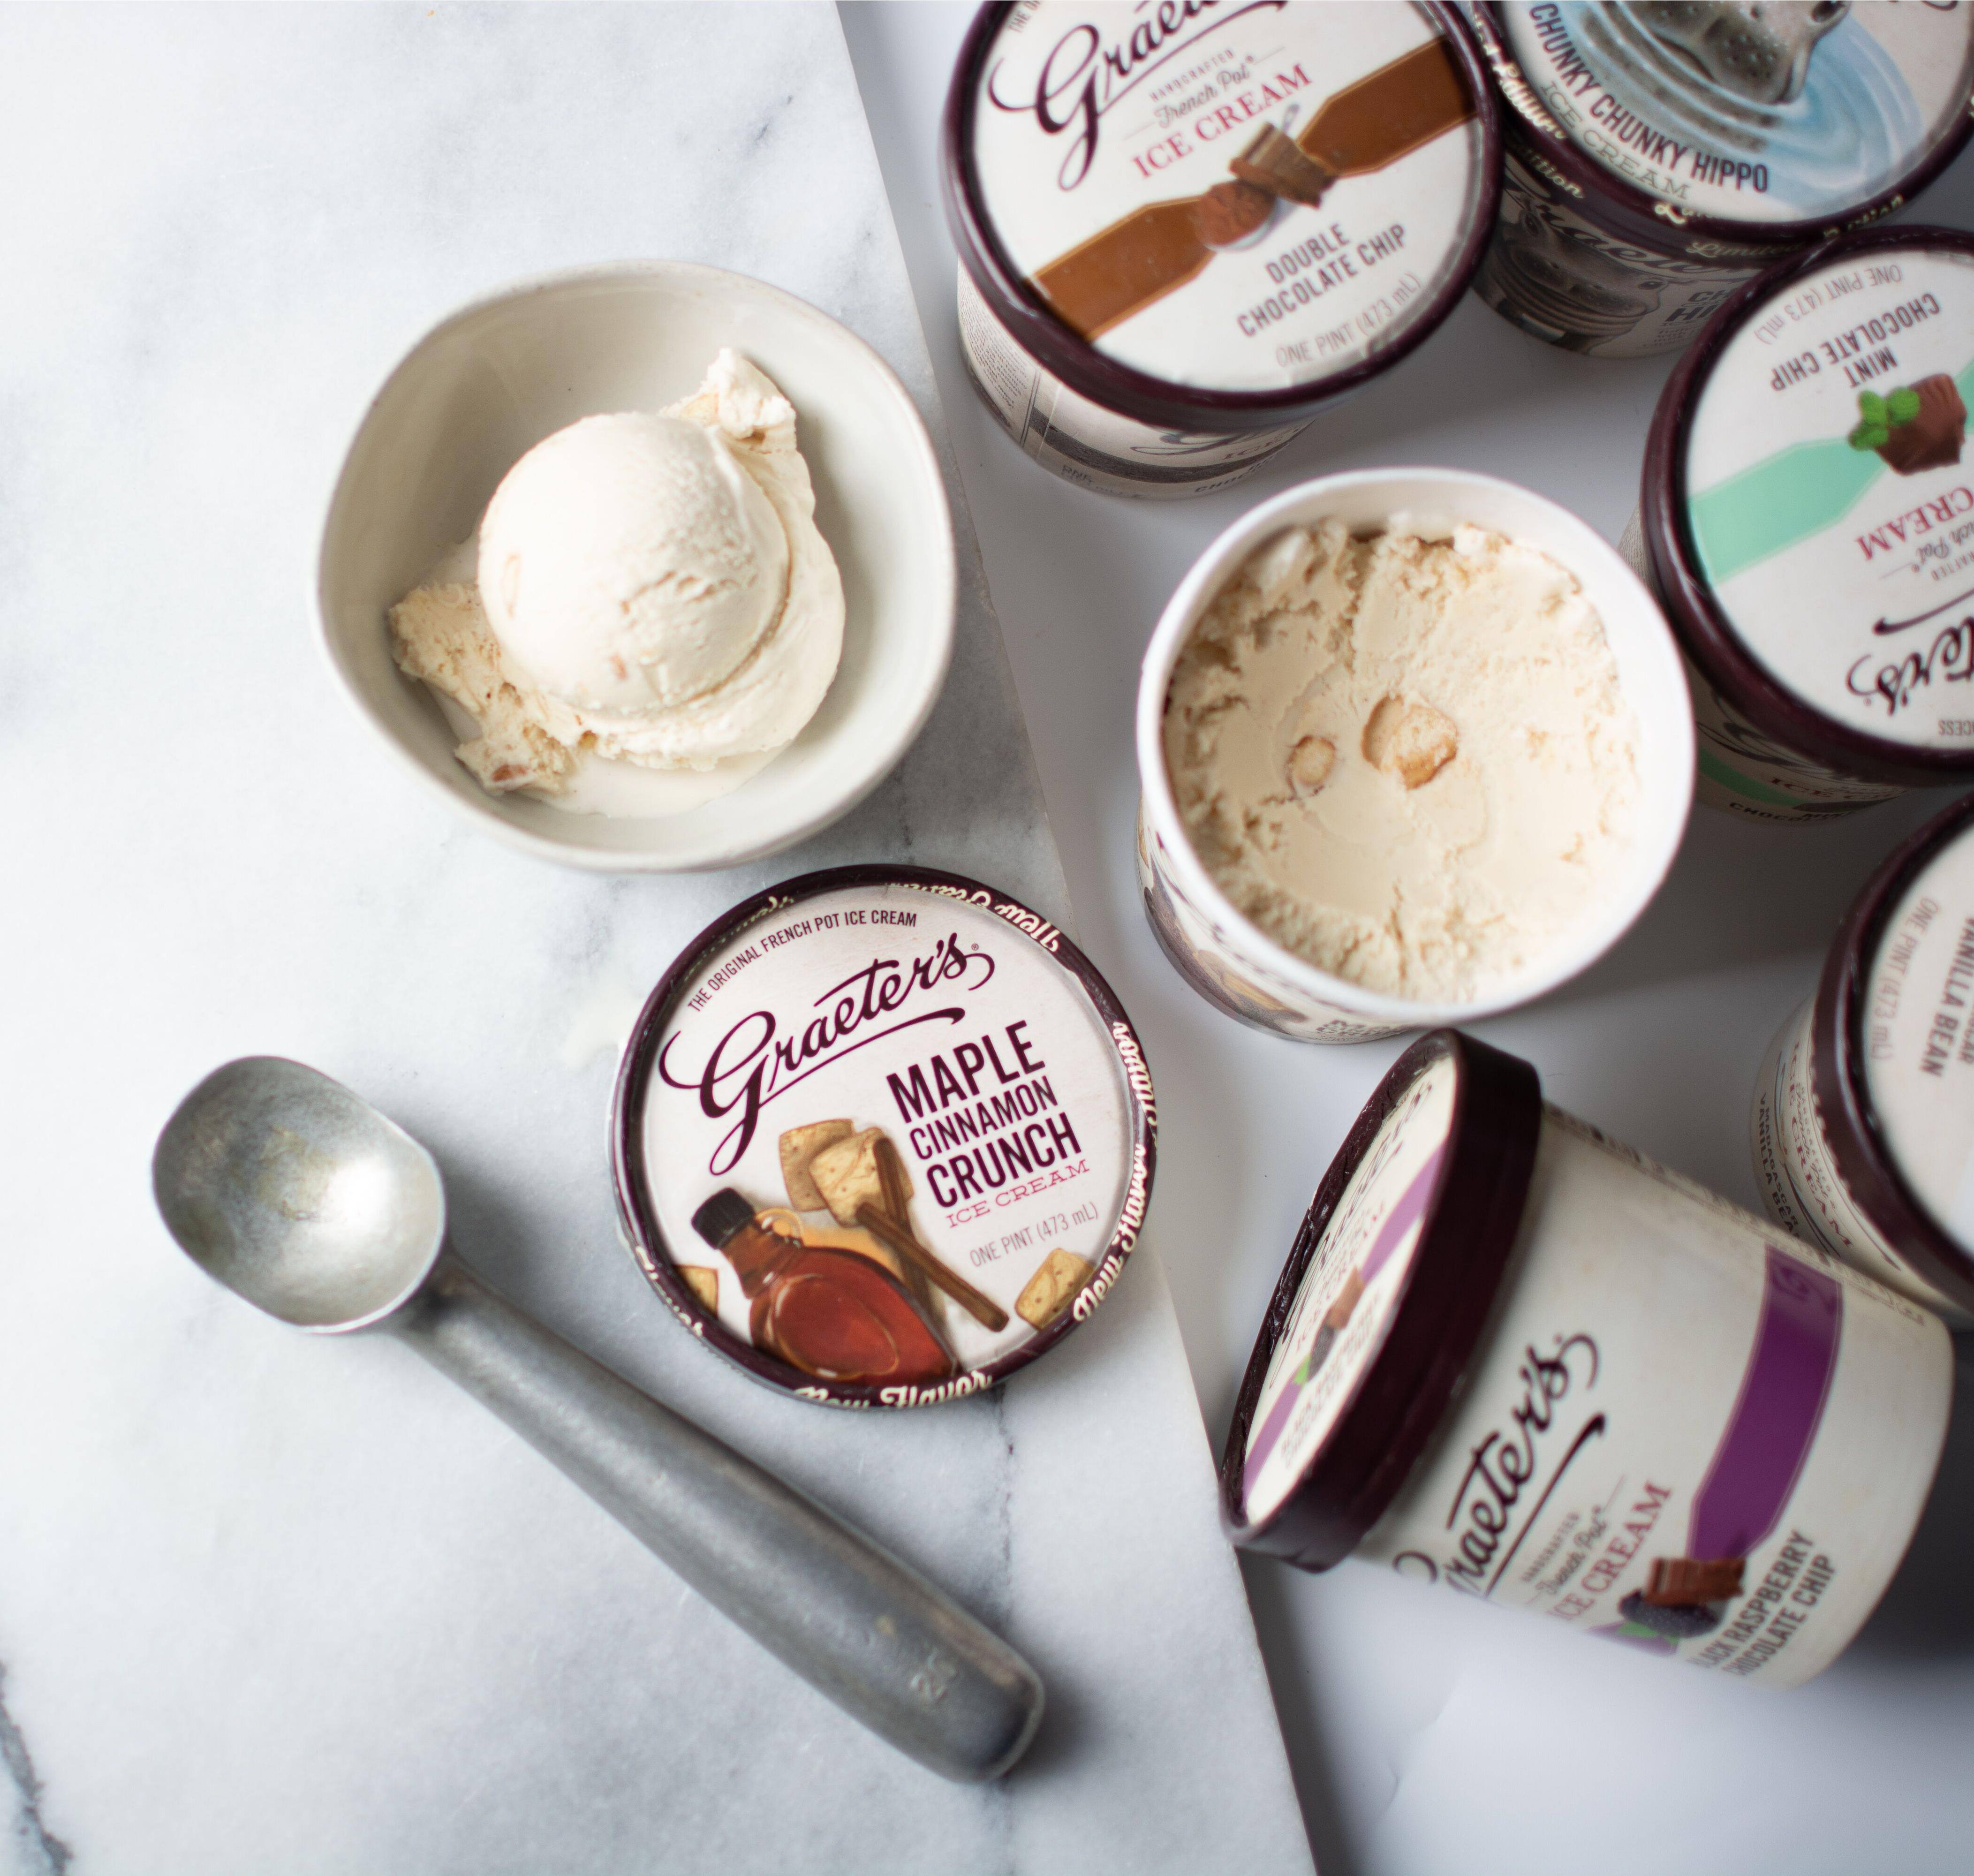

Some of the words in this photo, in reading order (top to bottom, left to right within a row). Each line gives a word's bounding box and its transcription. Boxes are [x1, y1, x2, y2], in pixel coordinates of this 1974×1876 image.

[1150, 50, 1234, 101] HANDCRAFTED
[1154, 83, 1218, 129] French
[1529, 2, 1600, 98] CHUNKY
[1589, 93, 1688, 172] CHUNKY
[1689, 151, 1769, 194] HIPPO
[1132, 132, 1194, 178] ICE
[1195, 63, 1313, 142] CREAM
[1540, 81, 1583, 129] ICE
[1583, 129, 1691, 201] CREAM
[1236, 253, 1358, 337] CHOCOLATE
[1356, 223, 1406, 267] CHIP
[1264, 223, 1350, 285] DOUBLE
[1824, 272, 1864, 300] PINT
[1865, 264, 1903, 287] ONE
[1275, 343, 1313, 368] ONE
[1316, 322, 1356, 356] PINT
[1355, 296, 1393, 336] (473
[1392, 272, 1422, 307] mL)
[1753, 313, 1785, 345] mL)
[1784, 287, 1824, 321] (473
[1819, 293, 1940, 365] CHOCOLATE
[1770, 351, 1820, 391] CHIP
[1843, 346, 1898, 388] MINT
[1854, 486, 1974, 560] CREAM
[1904, 897, 1939, 930] ONE
[687, 988, 713, 1012] THE
[708, 946, 763, 990] ORIGINAL
[760, 921, 813, 952] FRENCH
[815, 913, 840, 931] POT
[844, 911, 867, 926] ICE
[871, 910, 917, 928] CREAM
[1889, 930, 1919, 977] PINT
[1876, 976, 1902, 1020] (473
[659, 932, 995, 1175] Graeter's
[885, 1020, 1045, 1124] MAPLE
[1870, 1023, 1896, 1060] mL)
[1920, 1012, 1959, 1077] BEAN
[909, 1075, 1058, 1160] CINNAMON
[1760, 1092, 1774, 1186] VANILLA
[926, 1112, 1082, 1208] CRUNCH
[946, 1201, 991, 1228] ICE
[995, 1159, 1090, 1205] CREAM
[1763, 1106, 1800, 1226] MADAGASCAR
[1791, 1116, 1853, 1247] CREAM
[969, 1243, 1002, 1267] ONE
[1000, 1229, 1035, 1256] PINT
[1036, 1214, 1070, 1242] (473
[1071, 1201, 1099, 1227] mL)
[1073, 1253, 1124, 1321] New
[1111, 1143, 1148, 1253] Flavor
[1392, 1331, 1598, 1594] raeter's
[1580, 1480, 1673, 1594] CREAM
[1731, 1529, 1814, 1644] RASPBERRY
[1790, 1553, 1836, 1608] CHIP
